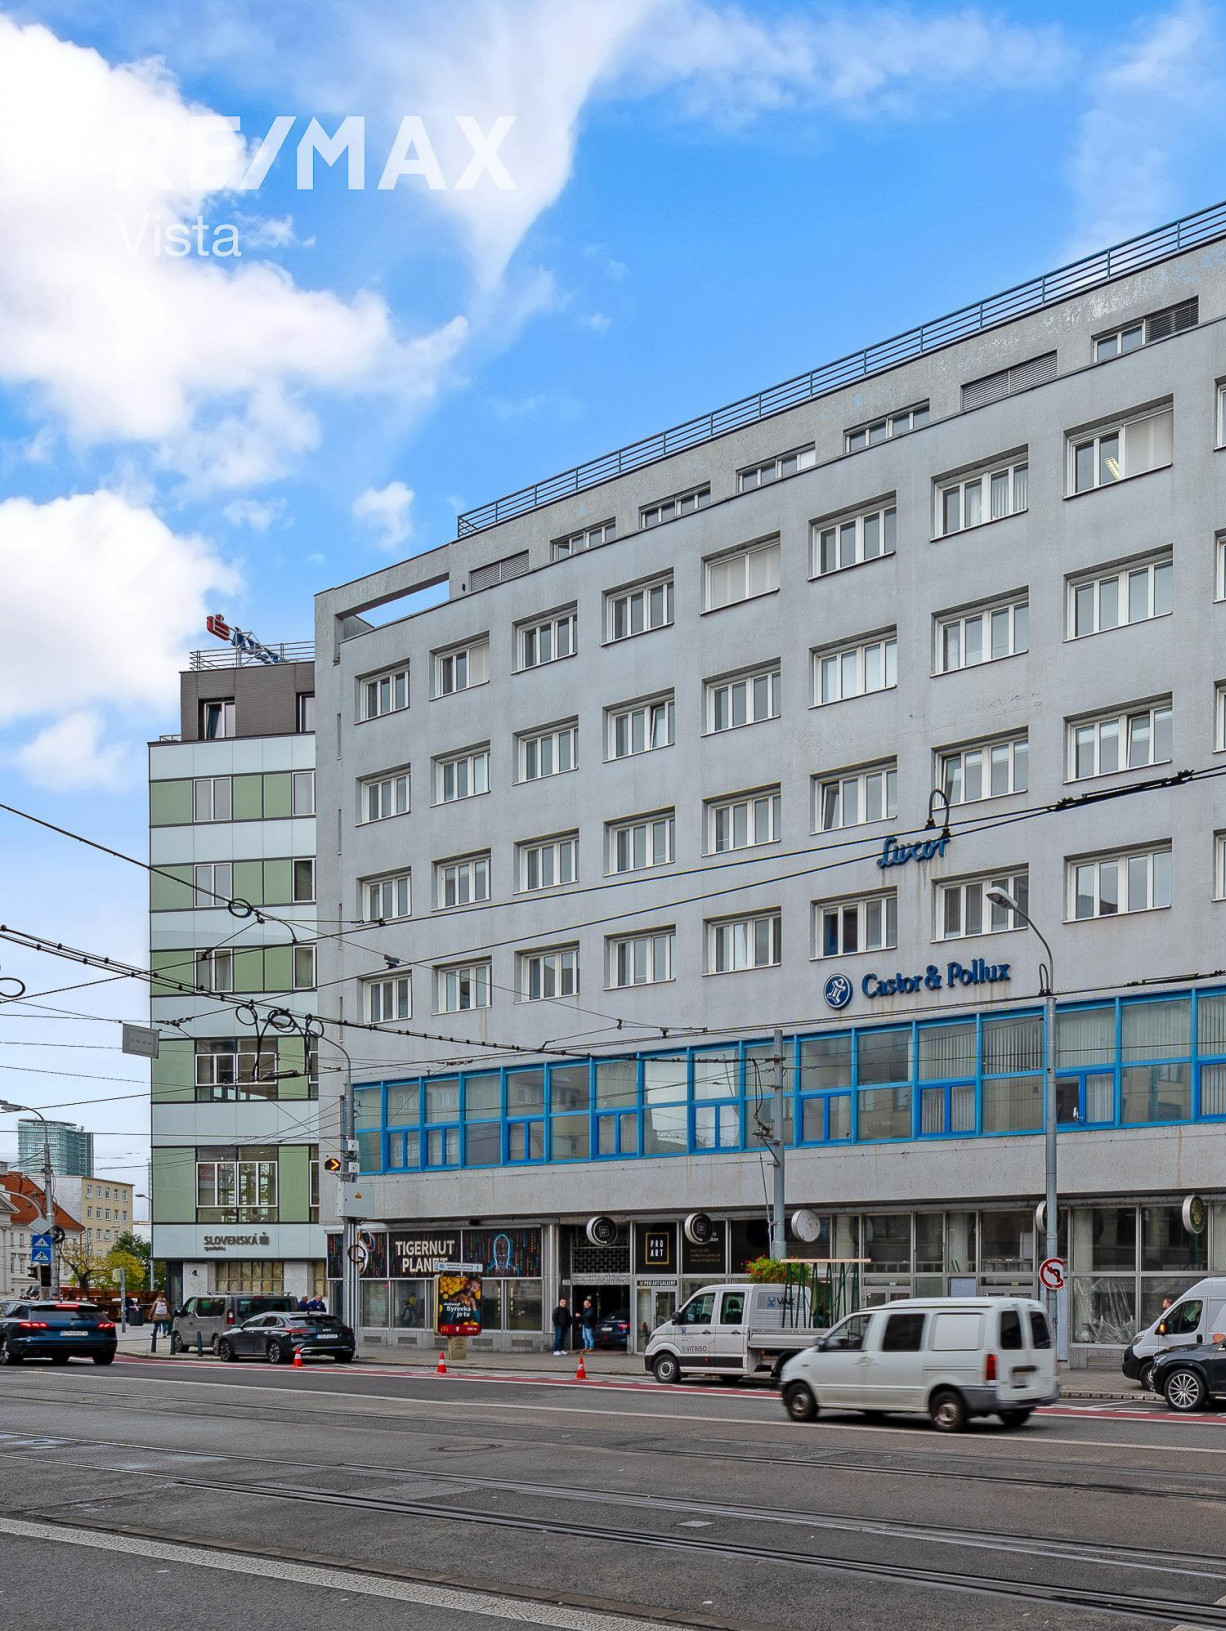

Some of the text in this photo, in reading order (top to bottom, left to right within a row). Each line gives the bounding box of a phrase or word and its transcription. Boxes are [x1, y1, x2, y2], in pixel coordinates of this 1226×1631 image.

[876, 837, 951, 869] Luxor
[862, 957, 1011, 998] Castor & Pollux
[203, 1232, 259, 1246] SLOVENSKÁ
[650, 1240, 664, 1248] PRO
[395, 1240, 456, 1256] TIGERNUT
[650, 1249, 664, 1257] ART
